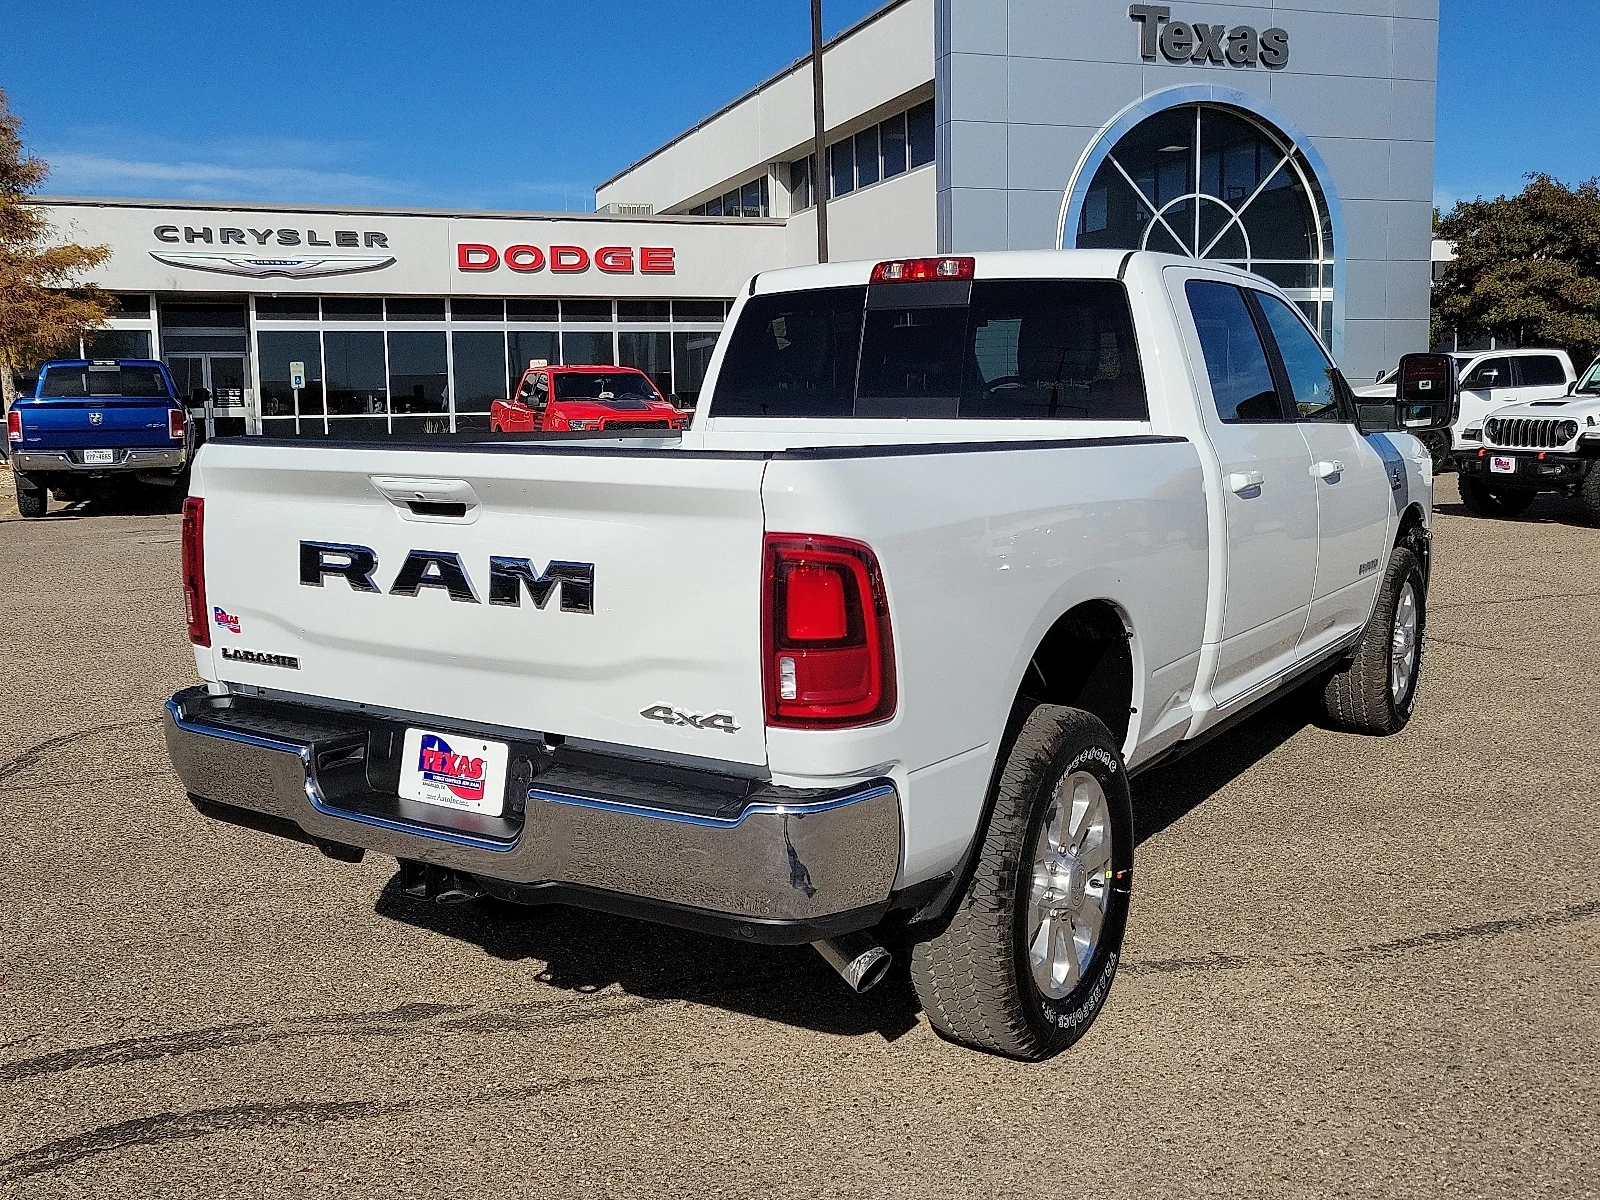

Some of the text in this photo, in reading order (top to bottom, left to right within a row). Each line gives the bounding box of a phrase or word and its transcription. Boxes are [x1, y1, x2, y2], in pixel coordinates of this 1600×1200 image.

[1129, 4, 1289, 70] Texas
[153, 225, 390, 249] CHRYSLER
[457, 243, 676, 276] DODGE
[299, 539, 596, 616] RAM
[221, 647, 302, 671] LARAMIE
[422, 748, 484, 780] TEXAS
